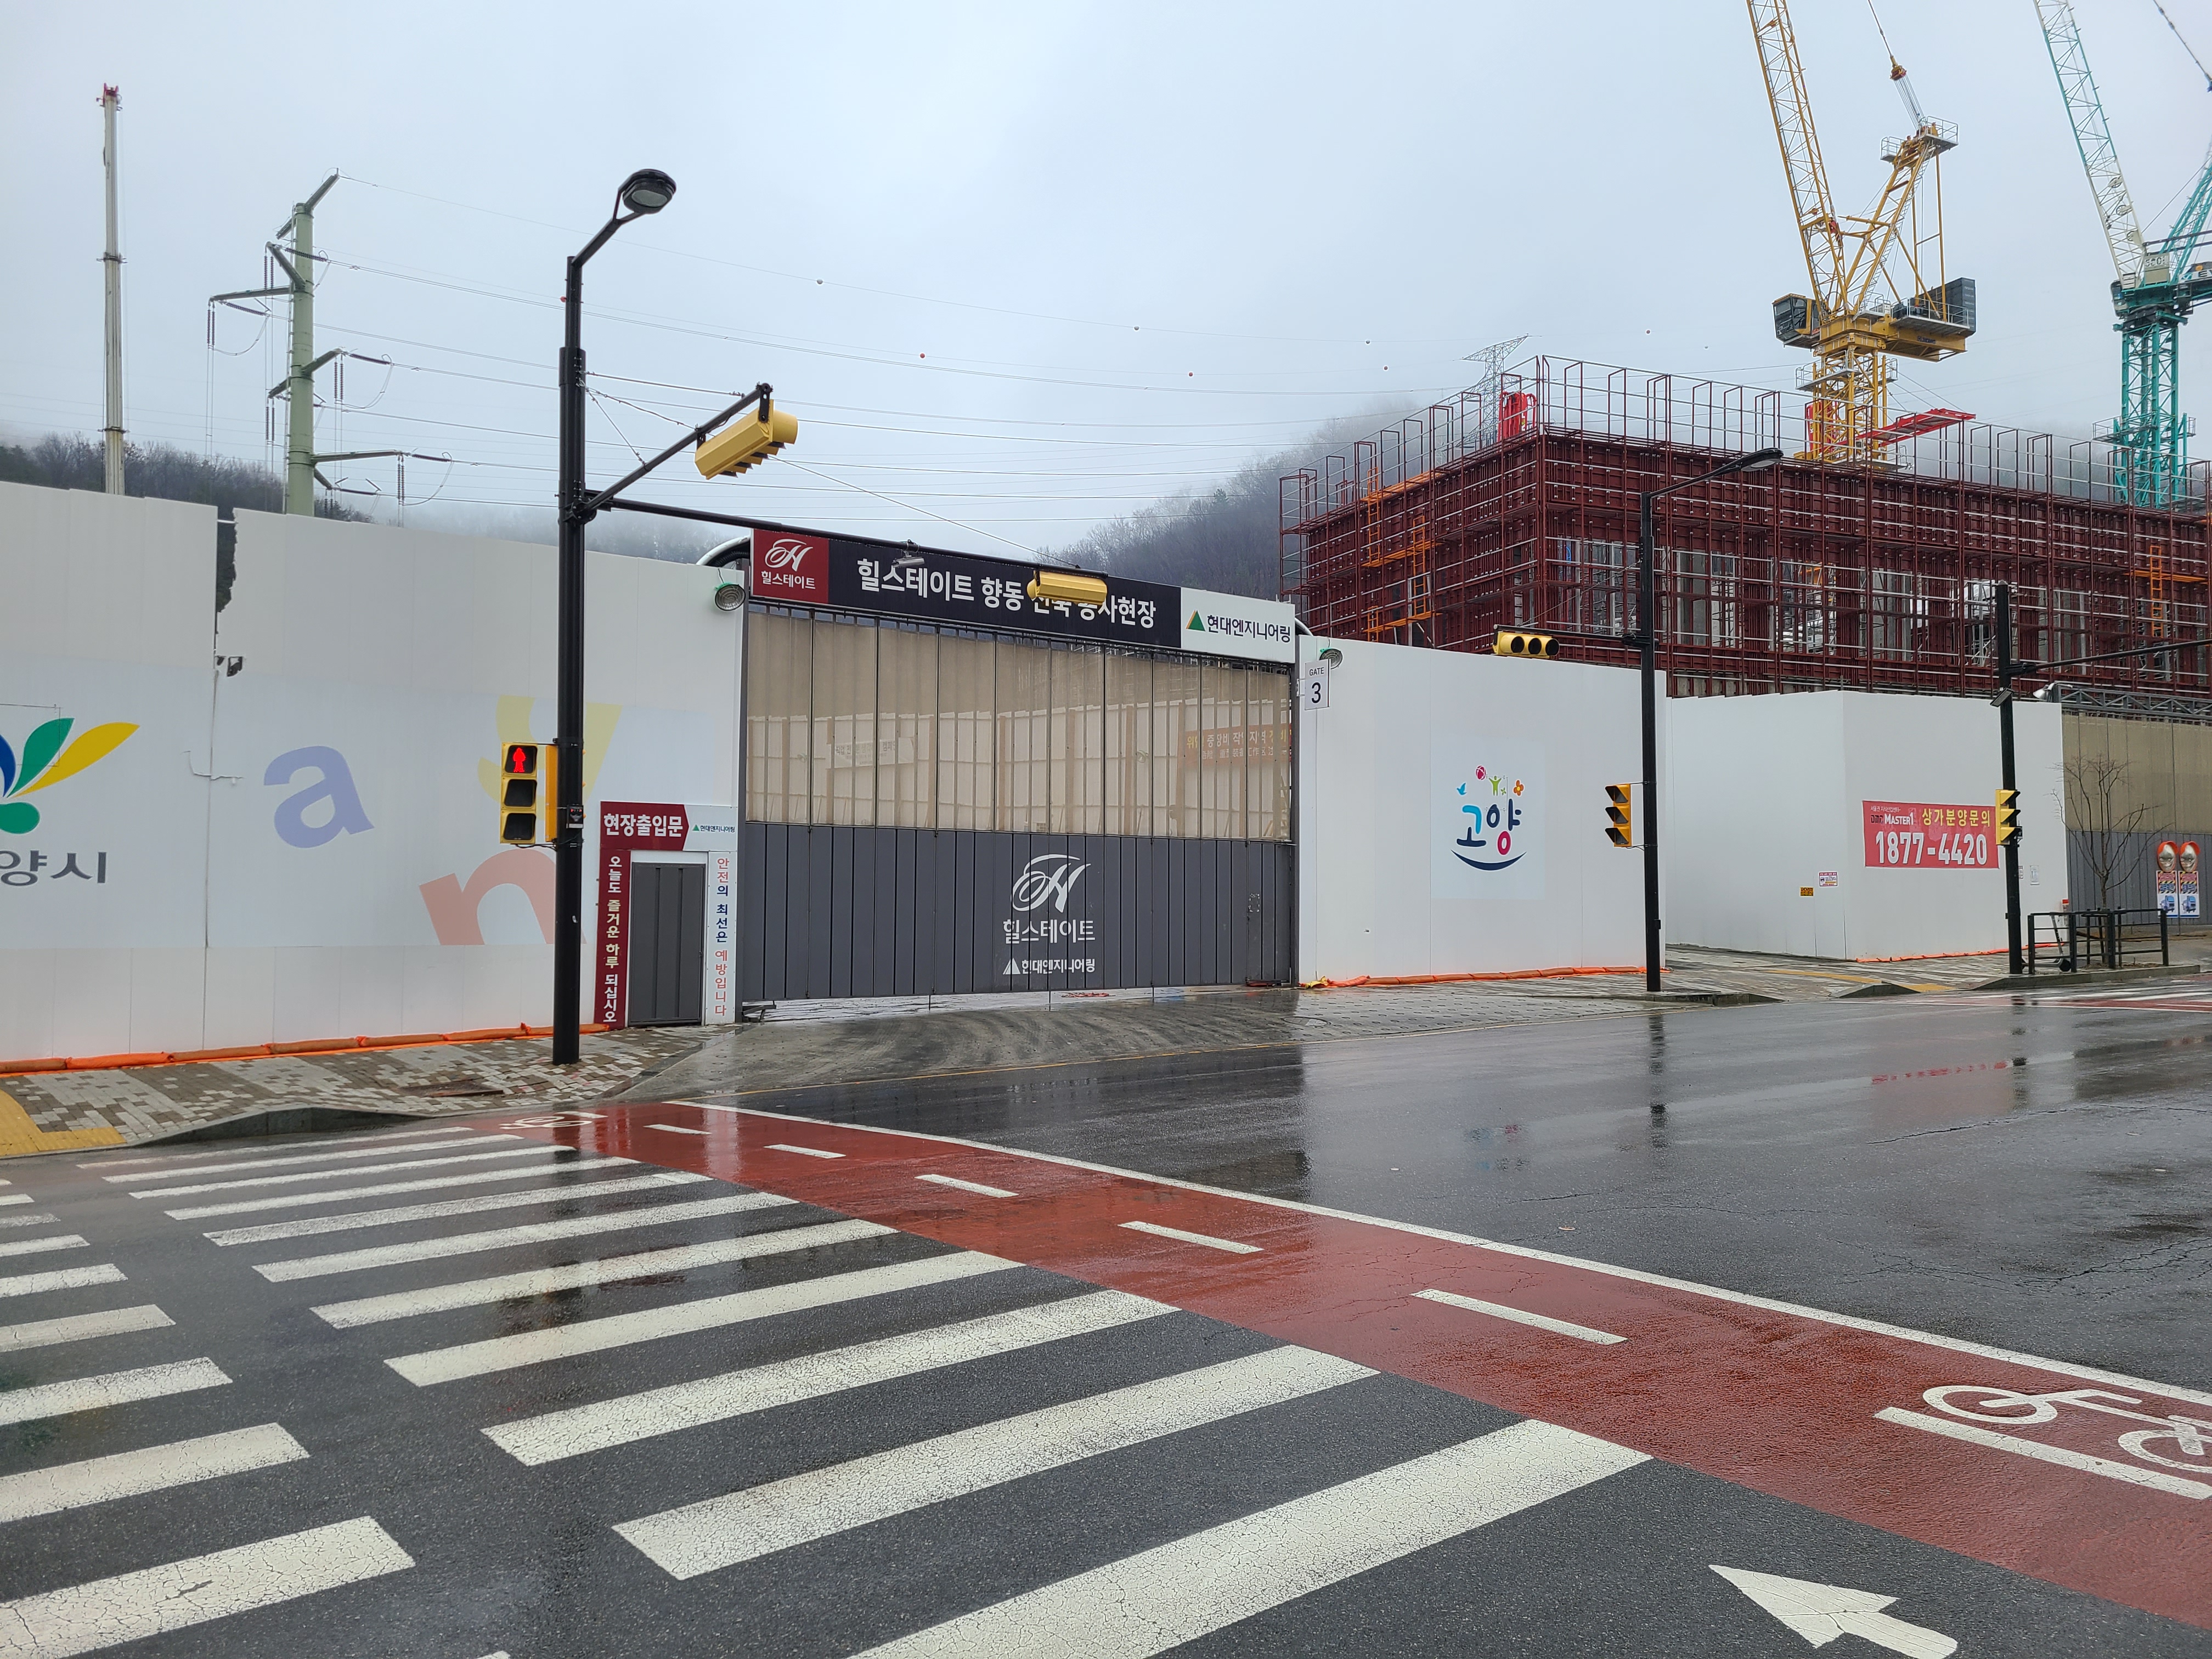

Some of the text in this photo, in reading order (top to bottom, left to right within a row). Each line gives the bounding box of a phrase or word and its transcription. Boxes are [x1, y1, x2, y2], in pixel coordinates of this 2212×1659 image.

[761, 570, 816, 590] 힐스테이트
[857, 558, 974, 602] 힐스테이트
[981, 577, 1024, 611] 향동
[1207, 614, 1291, 643] 현대엔지니어링
[1309, 667, 1324, 676] GATE
[1311, 682, 1321, 703] 3
[603, 813, 683, 838] 현장출입문
[700, 825, 735, 833] 현대엔지니어링
[1457, 799, 1522, 855] 고양
[1922, 808, 1990, 827] 상가분양문의
[1876, 831, 1988, 865] 1877-4420
[603, 856, 622, 1023] 오늘도 즐거운 하루 되십시오
[715, 857, 730, 1017] 안전의 최선은 예방입니다
[1003, 919, 1096, 944] 힐스테이트
[1022, 958, 1095, 974] 현대엔지니어링
